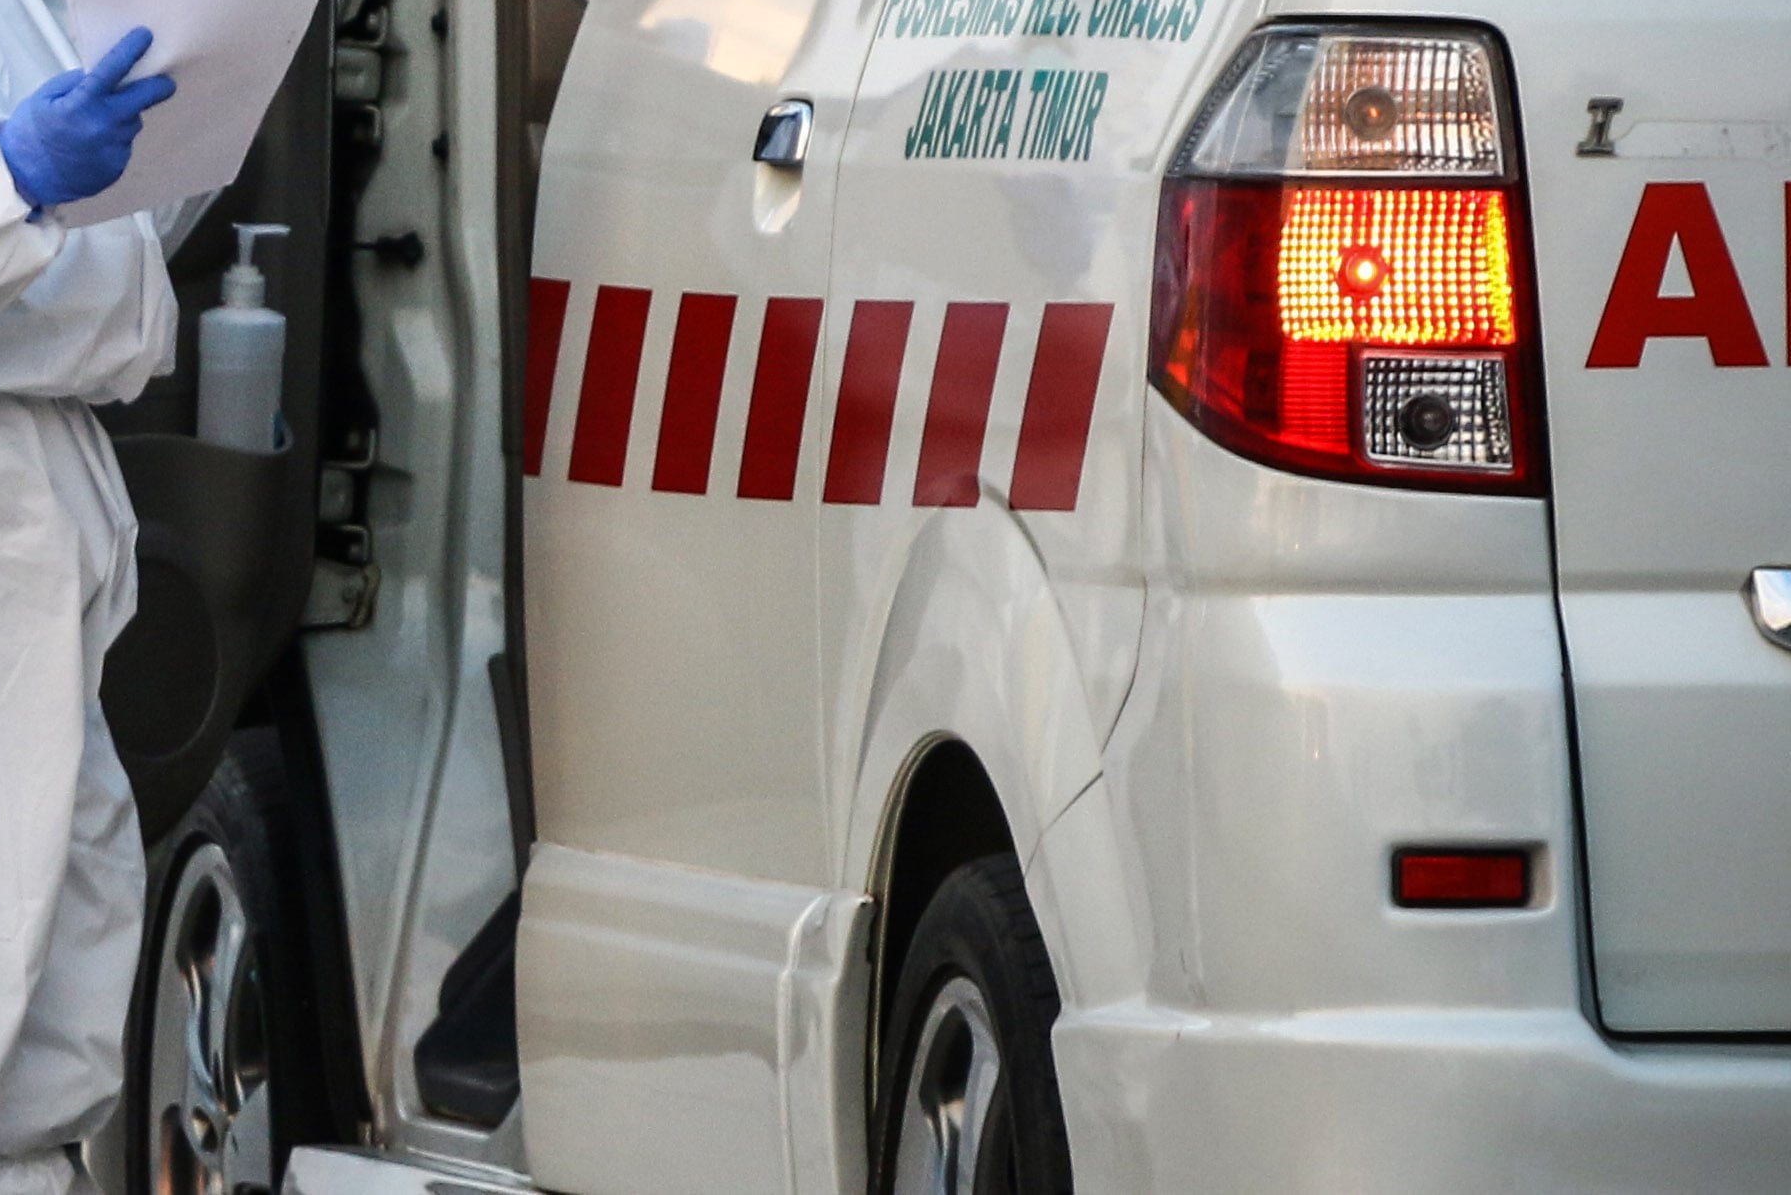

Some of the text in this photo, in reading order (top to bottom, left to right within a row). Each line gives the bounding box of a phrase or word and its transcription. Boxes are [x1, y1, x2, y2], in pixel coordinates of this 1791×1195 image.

[905, 69, 1108, 161] JAKARTA TIMUR
[1585, 180, 1791, 368] A
